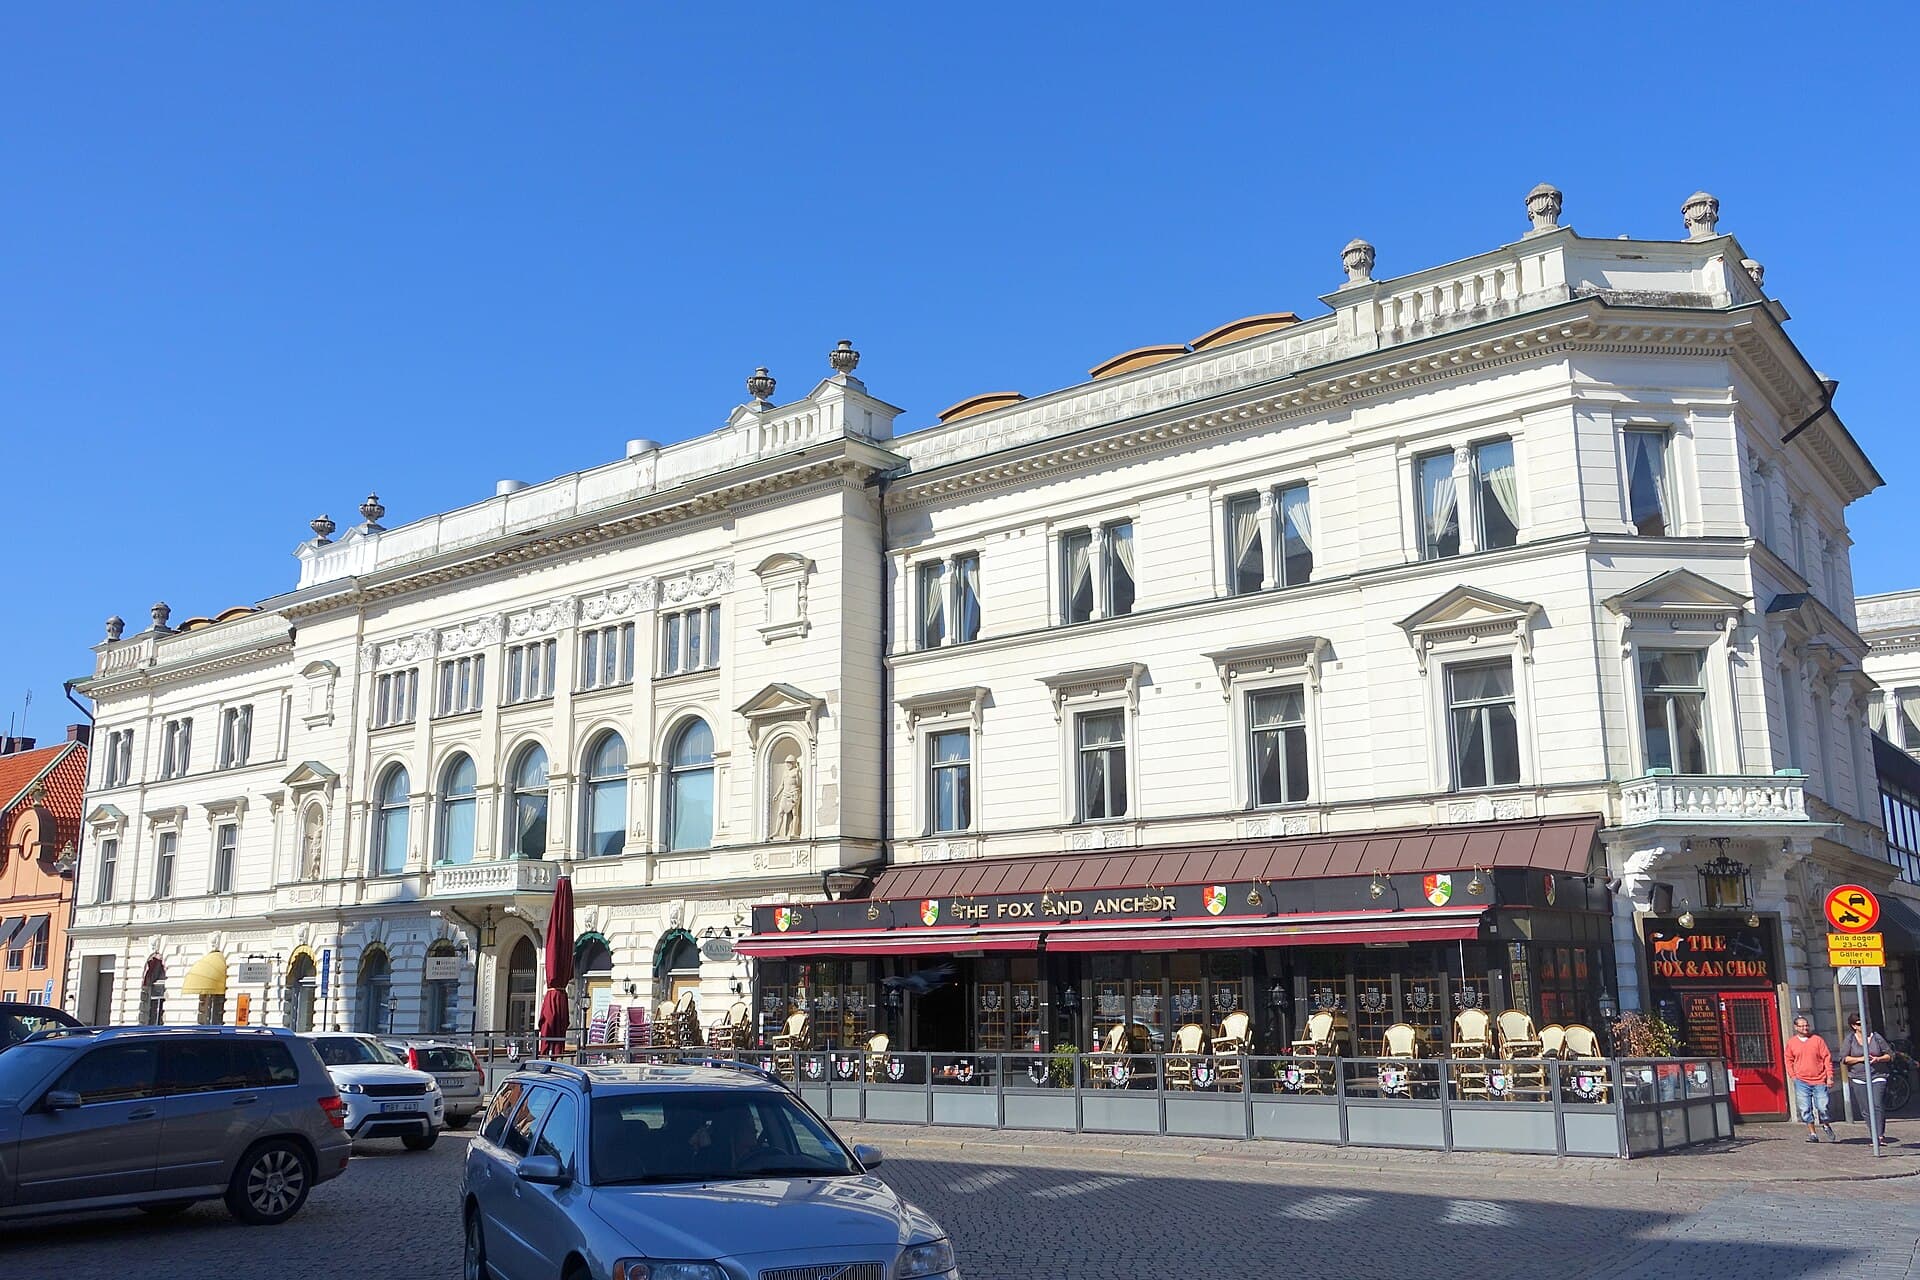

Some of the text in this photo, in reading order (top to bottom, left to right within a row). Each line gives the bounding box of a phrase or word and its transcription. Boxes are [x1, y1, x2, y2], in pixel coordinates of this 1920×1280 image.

[958, 896, 1176, 919] THE FOX AND ANCHOR
[1687, 935, 1727, 952] THE
